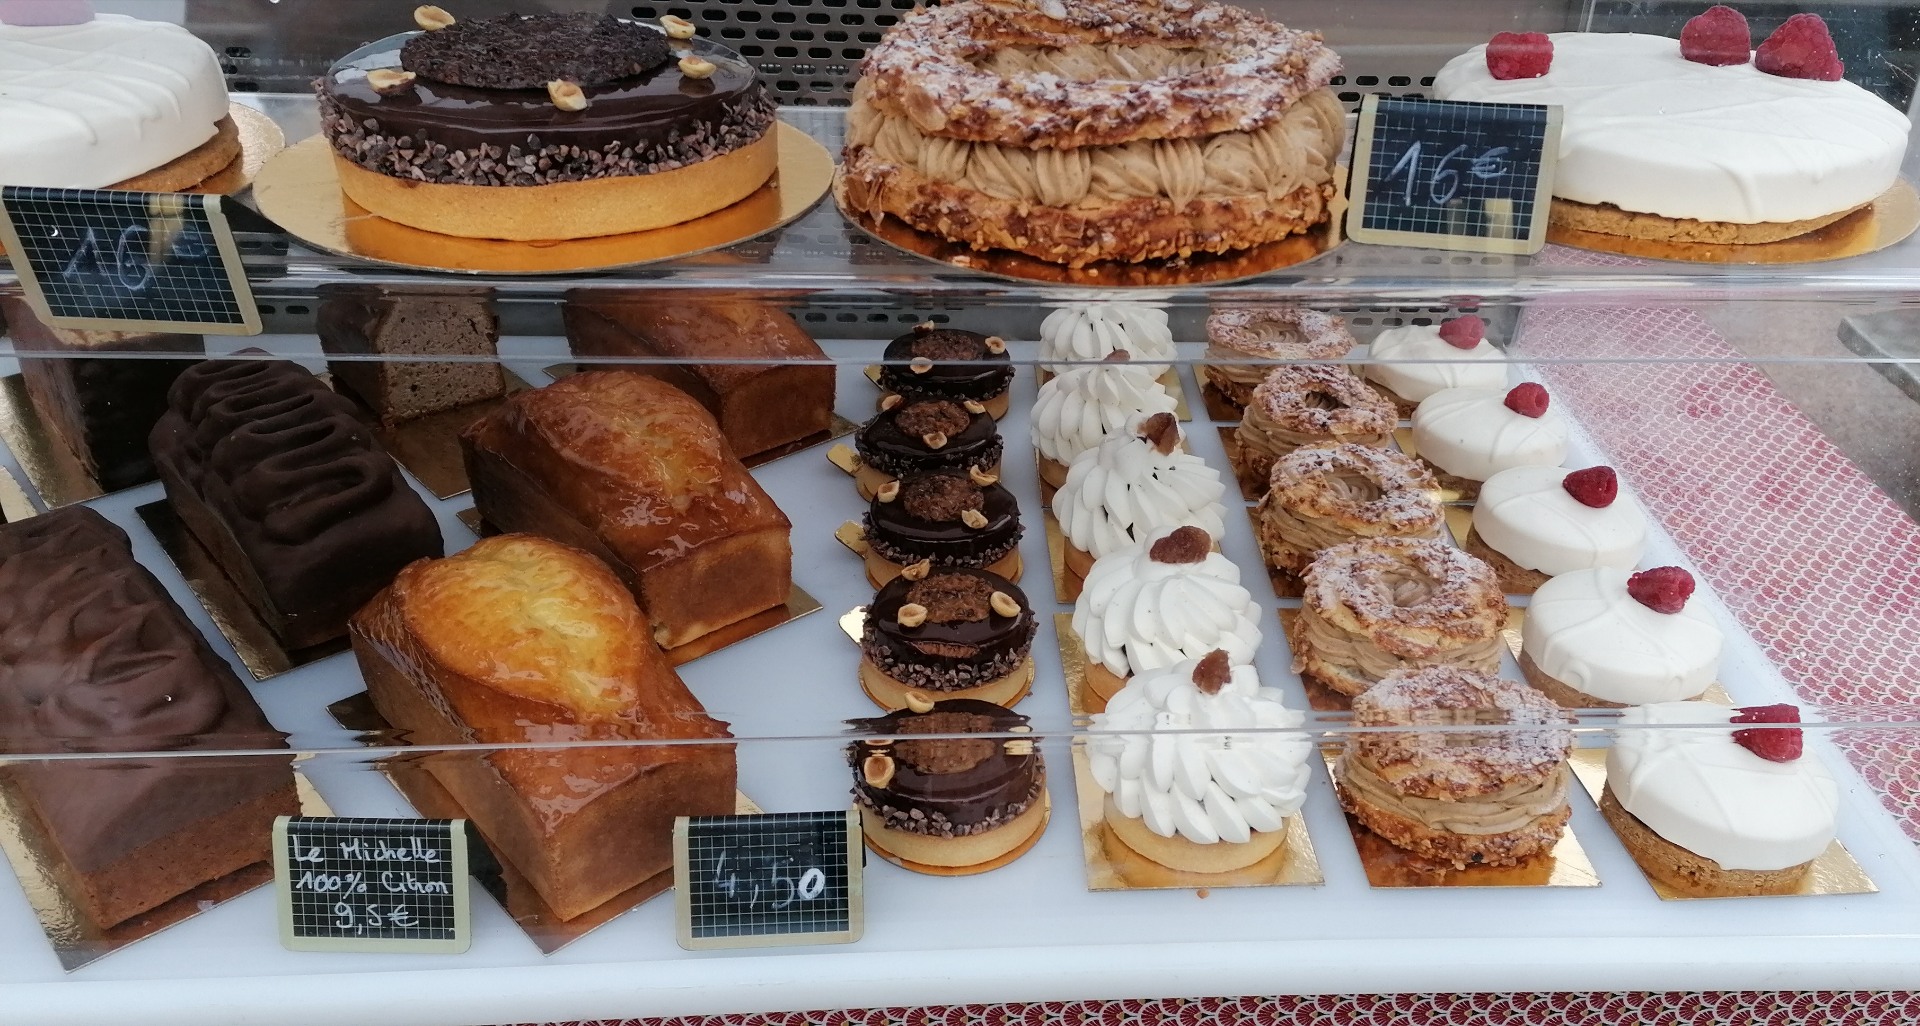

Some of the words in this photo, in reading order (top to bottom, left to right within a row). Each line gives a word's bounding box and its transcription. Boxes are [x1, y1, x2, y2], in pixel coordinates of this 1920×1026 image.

[1384, 140, 1509, 207] 16€
[292, 834, 324, 863] Le
[339, 835, 440, 863] Michelle
[296, 870, 367, 900] 100%
[381, 871, 448, 894] Citron
[714, 850, 826, 910] 4,50
